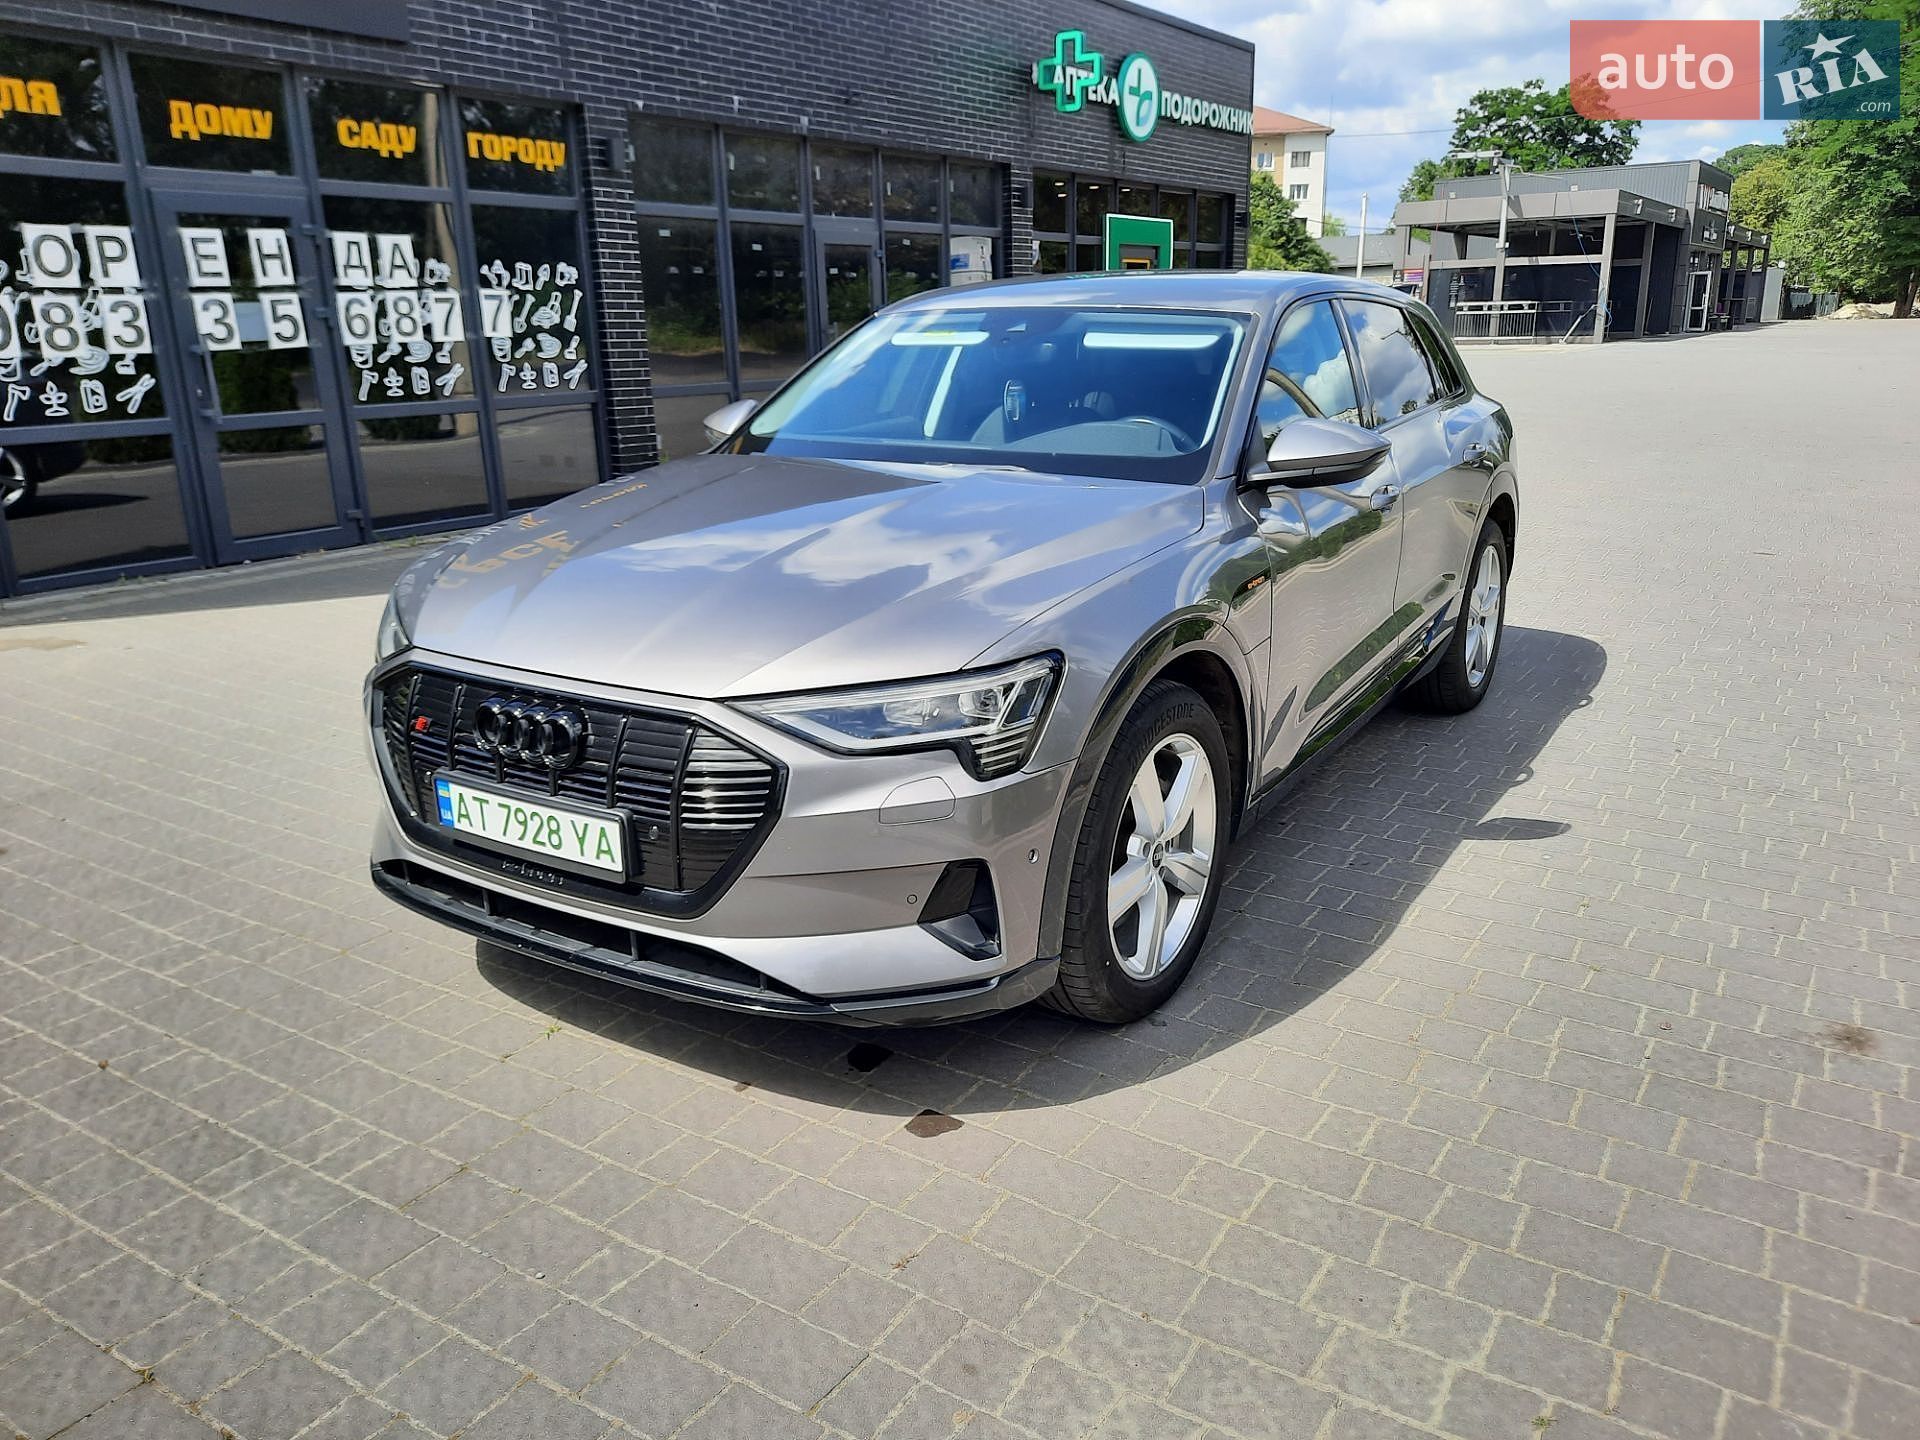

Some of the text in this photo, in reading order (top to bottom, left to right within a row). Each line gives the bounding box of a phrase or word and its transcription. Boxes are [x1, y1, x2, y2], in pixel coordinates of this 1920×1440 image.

[0, 76, 566, 172] ЛЯ ДОМУ САДУ ГОРОДУ
[1161, 90, 1254, 135] ПОДОРОЖНИК
[457, 792, 615, 863] AT 7928 YA
